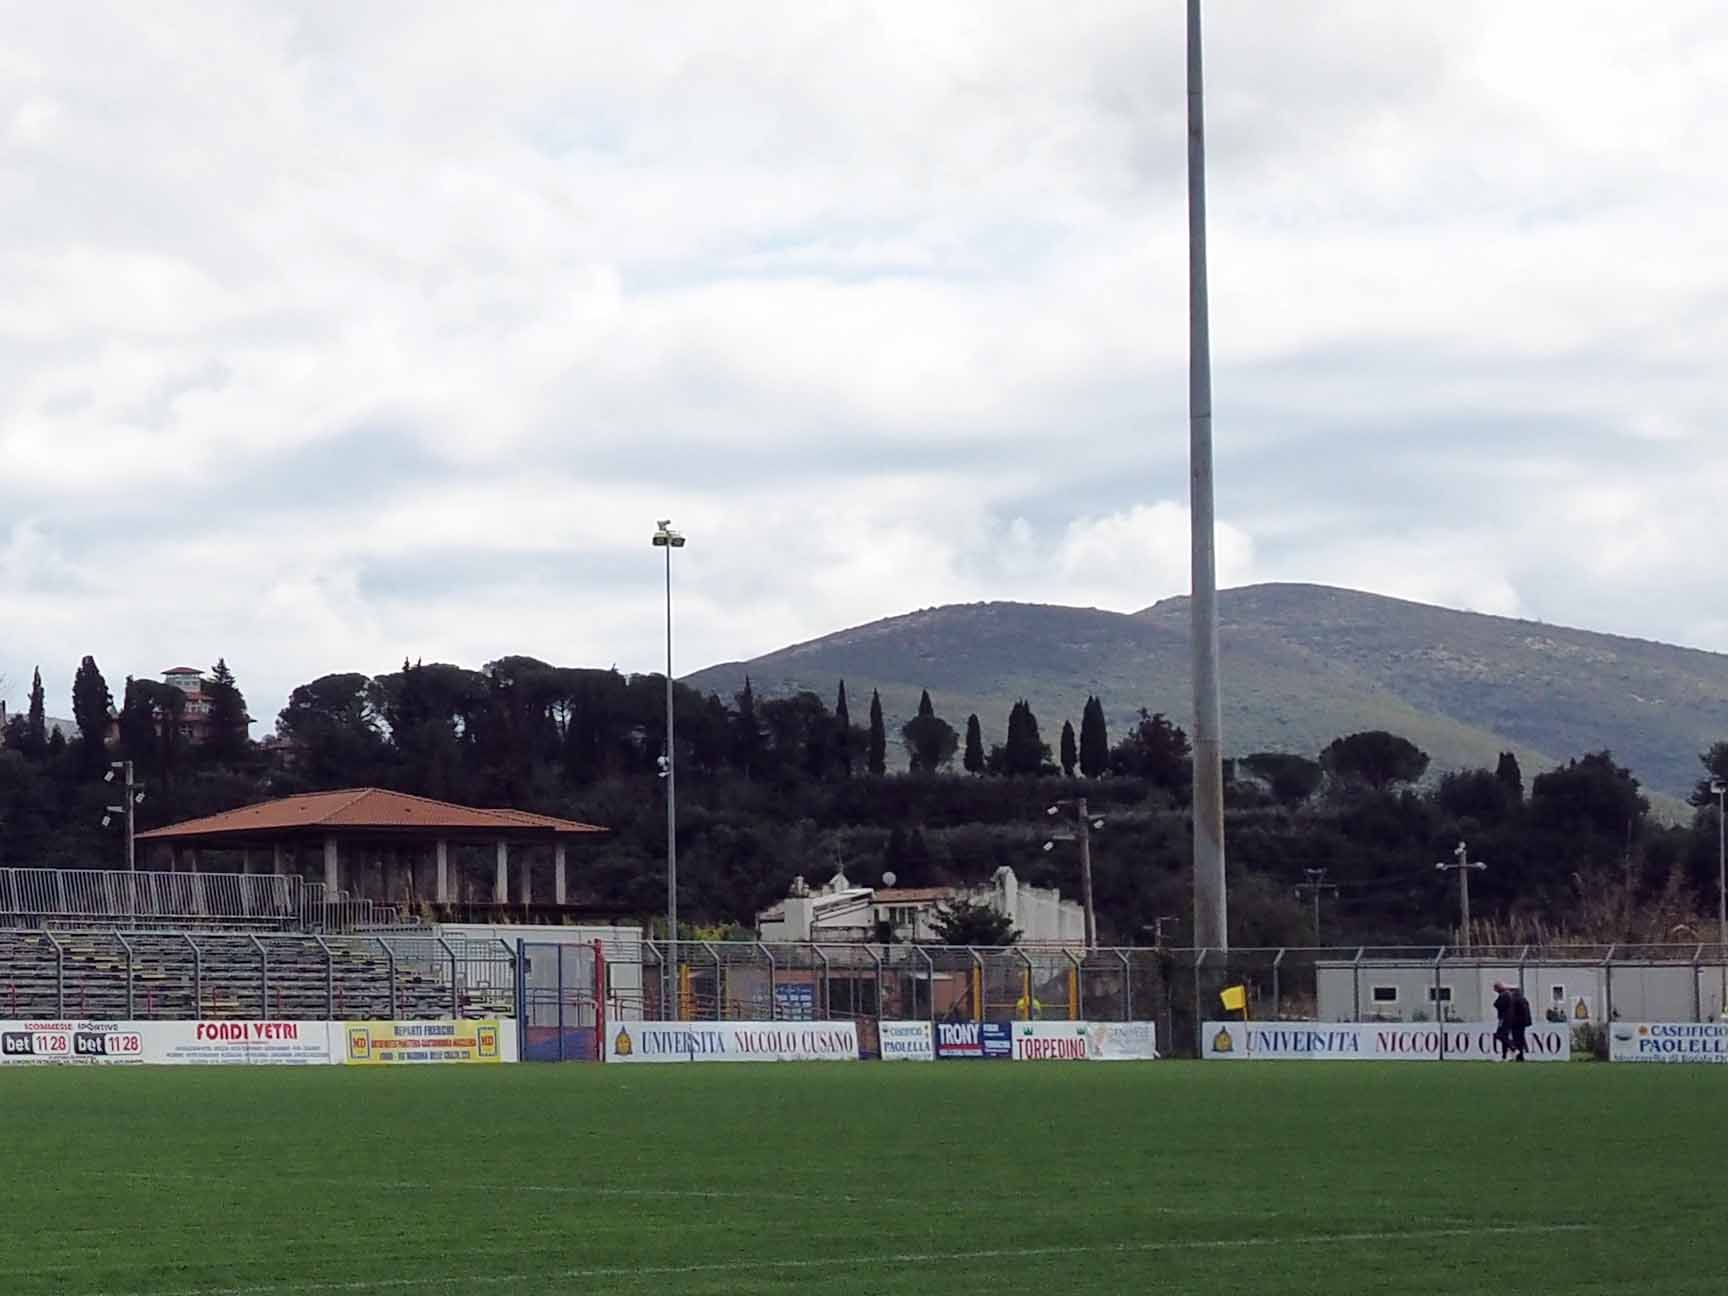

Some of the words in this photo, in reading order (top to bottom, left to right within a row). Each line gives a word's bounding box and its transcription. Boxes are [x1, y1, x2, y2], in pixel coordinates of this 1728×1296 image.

[196, 1023, 248, 1040] FONDI
[253, 1023, 298, 1039] VETRI
[938, 1023, 980, 1044] TRONY
[801, 1031, 853, 1054] CUSANO
[1016, 1039, 1086, 1058] TORPEDINO
[1639, 1039, 1728, 1052] PAOLELL
